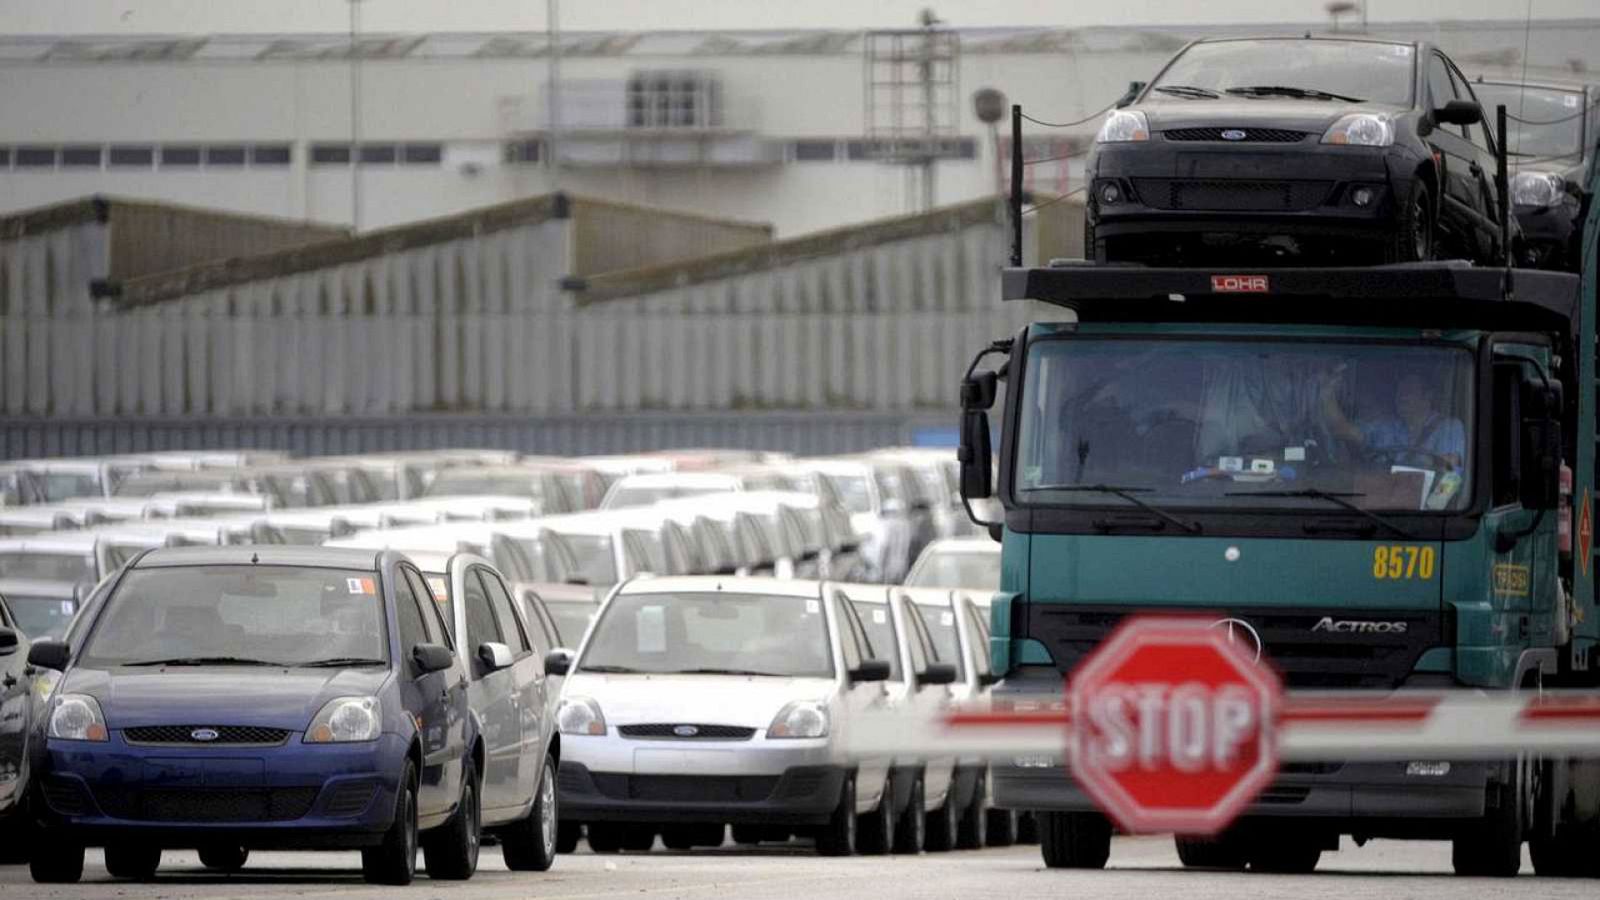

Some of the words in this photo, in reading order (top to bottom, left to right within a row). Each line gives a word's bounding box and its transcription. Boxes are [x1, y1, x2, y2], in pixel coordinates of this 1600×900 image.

[1214, 278, 1266, 289] LOHR
[1374, 545, 1434, 579] 8570
[1087, 683, 1252, 770] STOP
